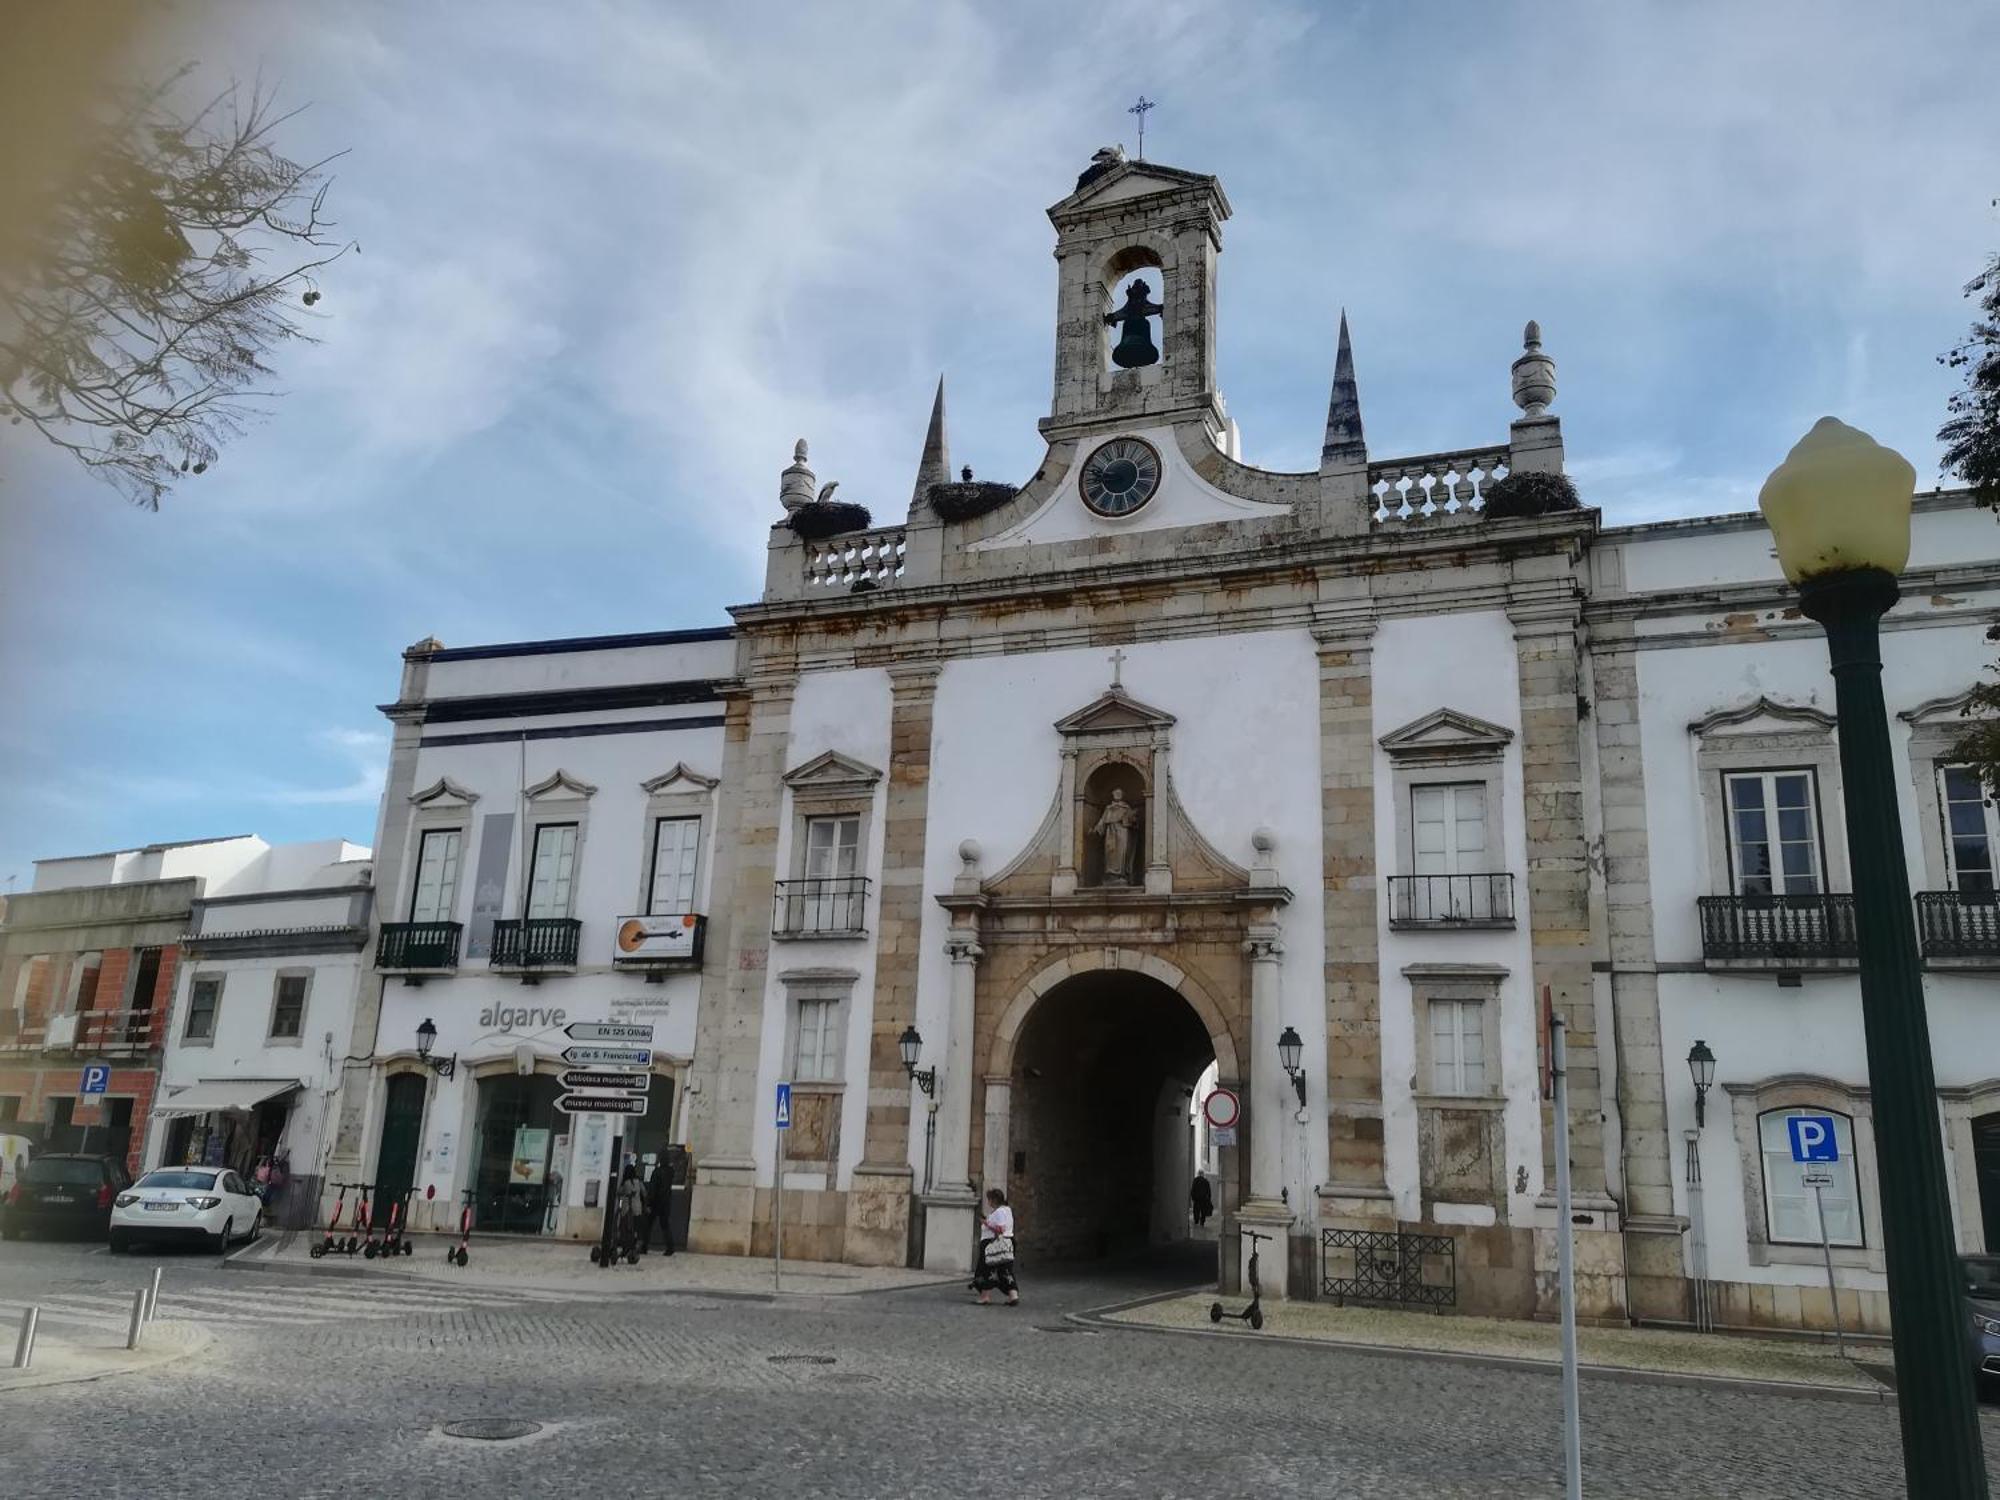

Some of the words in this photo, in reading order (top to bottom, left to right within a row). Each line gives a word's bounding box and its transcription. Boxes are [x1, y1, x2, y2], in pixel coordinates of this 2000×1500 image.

[480, 1001, 566, 1033] algarve
[598, 1028, 609, 1036] EN
[612, 1028, 625, 1036] 125
[602, 1051, 637, 1060] Francisco
[85, 1068, 103, 1091] P
[567, 1073, 601, 1084] biblioteca
[602, 1075, 636, 1086] municipal
[564, 1099, 593, 1109] museu
[594, 1100, 632, 1110] municipal
[1797, 1121, 1825, 1158] P
